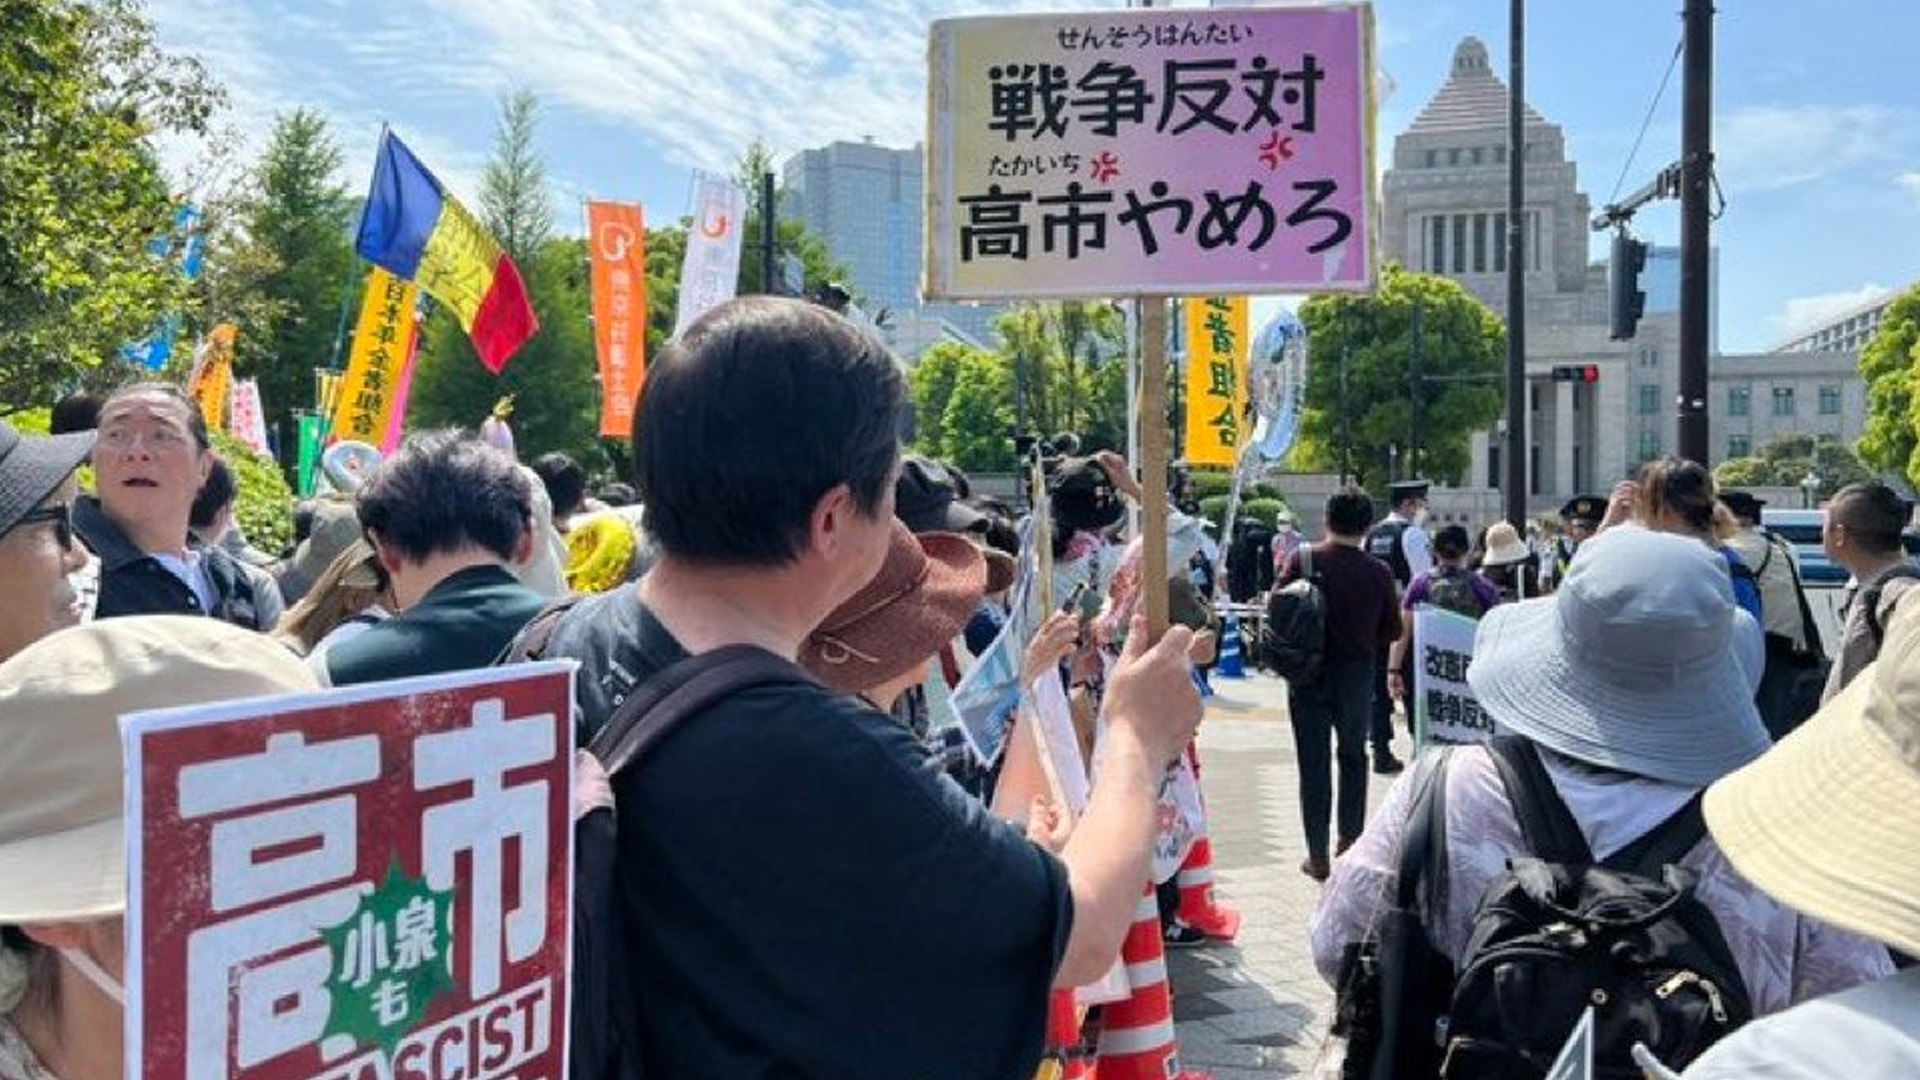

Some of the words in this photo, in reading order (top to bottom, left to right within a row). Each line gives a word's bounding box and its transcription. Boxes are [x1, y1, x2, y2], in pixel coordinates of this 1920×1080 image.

[1057, 24, 1254, 49] せんそうはんたい
[988, 54, 1325, 141] 戦争反対
[988, 152, 1080, 177] たかいち
[957, 180, 1354, 262] 高市やめろ
[178, 698, 557, 1080] 高市
[338, 895, 439, 988] 小泉
[370, 979, 409, 1026] も
